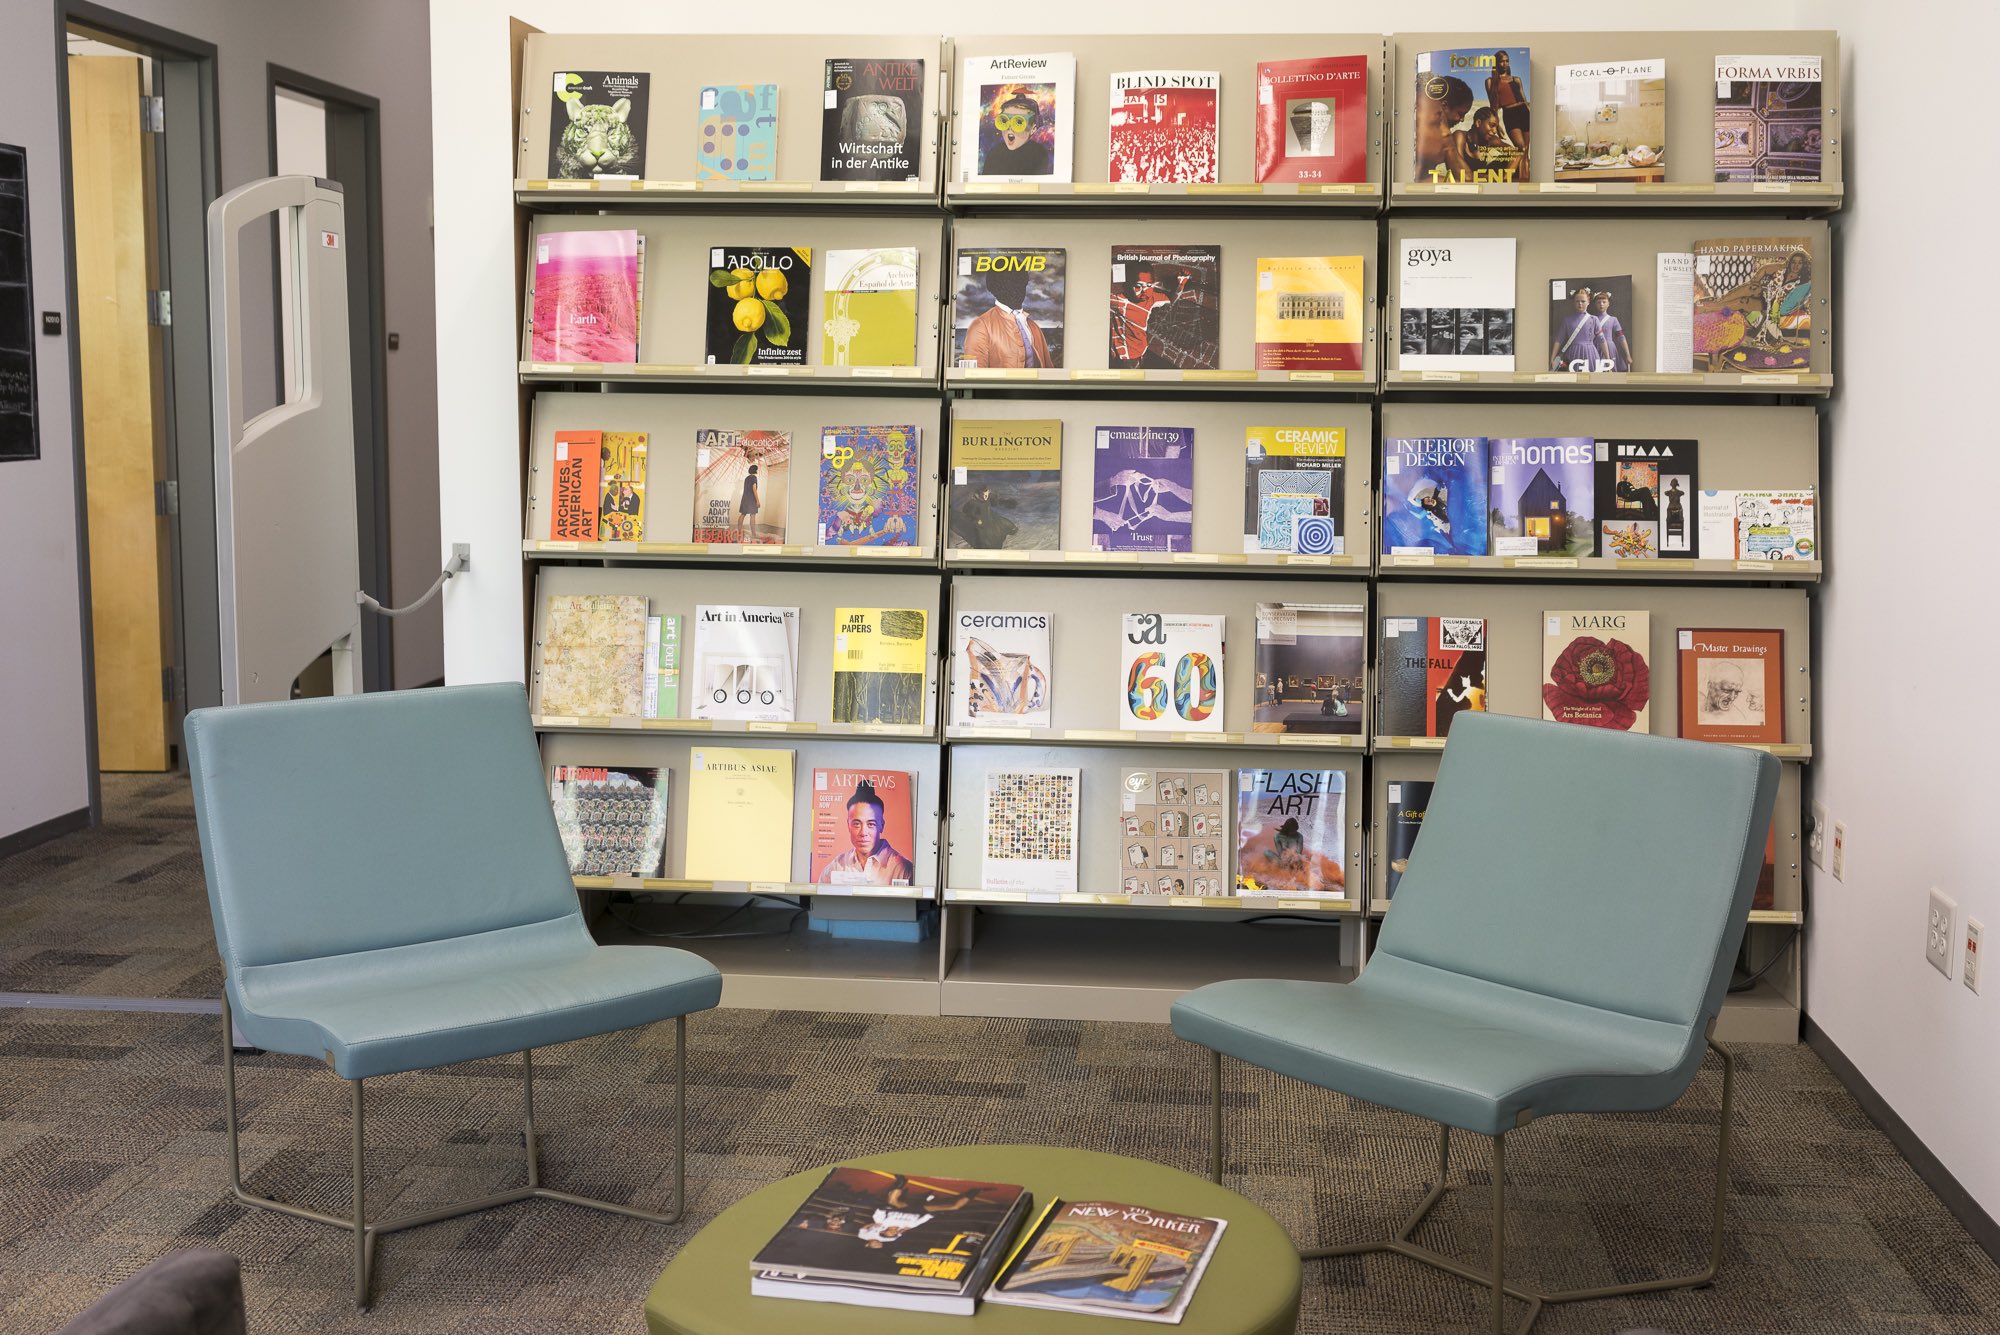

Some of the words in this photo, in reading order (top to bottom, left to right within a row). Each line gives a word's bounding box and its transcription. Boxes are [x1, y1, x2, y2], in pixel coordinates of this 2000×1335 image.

[990, 58, 1047, 69] ArtReview
[1449, 53, 1496, 68] foam
[863, 62, 918, 76] ANTIKE
[1570, 68, 1601, 78] FOCAL
[1620, 65, 1653, 75] PLANE
[1717, 66, 1773, 79] FORMA
[1776, 66, 1820, 79] VRBIS
[602, 75, 639, 85] Animals
[878, 76, 918, 91] WELT
[1117, 76, 1166, 89] BLIND
[1171, 76, 1214, 88] SPOT
[1264, 73, 1324, 84] BOLLETTINO
[1326, 71, 1361, 81] D'ARTE
[839, 142, 903, 154] Wirtschaft
[831, 157, 842, 168] in
[846, 157, 867, 168] der
[870, 157, 909, 169] Antike
[1298, 170, 1322, 179] 33-34
[1428, 168, 1516, 183] TALENT
[327, 234, 335, 246] 3M
[1700, 245, 1730, 254] HAND
[1733, 244, 1804, 253] PAPERMAKING
[727, 255, 793, 270] APOLLO
[975, 255, 1047, 272] BOMB
[1138, 254, 1163, 262] Journal
[1172, 254, 1215, 262] Photography
[1407, 248, 1452, 266] goya
[859, 279, 887, 289] Español
[898, 279, 914, 287] Arte
[570, 313, 597, 324] Earth
[758, 347, 786, 356] Infinite
[787, 348, 802, 356] zest
[1568, 358, 1615, 373] GUP
[704, 432, 737, 447] ART
[962, 436, 1052, 447] BURLINGTON
[1275, 430, 1339, 443] CERAMIC
[1293, 442, 1337, 455] REVIEW
[1396, 439, 1475, 453] INTERIOR
[1512, 440, 1592, 465] homes
[1405, 452, 1466, 467] DESIGN
[557, 466, 571, 538] ARCHIVES
[569, 458, 582, 538] AMERICAN
[709, 499, 731, 508] GROW
[708, 507, 731, 516] ADAPT
[581, 508, 592, 538] ART
[702, 515, 730, 524] SUSTAIN
[1130, 532, 1153, 541] Trust
[569, 601, 582, 610] Art
[701, 610, 721, 622] Art
[725, 611, 737, 622] in
[738, 610, 783, 624] America
[849, 614, 865, 623] ART
[960, 615, 1046, 629] ceramics
[1572, 615, 1626, 628] MARG
[666, 617, 676, 640] art
[841, 624, 872, 633] PAPERS
[1693, 643, 1728, 652] Master
[1732, 644, 1768, 655] Drawings
[663, 643, 677, 689] journal
[1405, 657, 1426, 668] THE
[1428, 658, 1453, 670] FALL
[1127, 651, 1217, 722] 60
[554, 767, 609, 781] ARTFORUM
[706, 763, 747, 771] ARTIBUS
[751, 764, 777, 773] ASIAE
[831, 773, 896, 789] ARTNEWS
[1255, 772, 1333, 793] FLASH
[819, 801, 831, 809] NOW
[1266, 794, 1320, 815] ART
[1405, 810, 1418, 818] Gift
[1129, 1207, 1151, 1215] THE
[1068, 1206, 1120, 1217] NEW
[1122, 1210, 1201, 1234] YORKER
